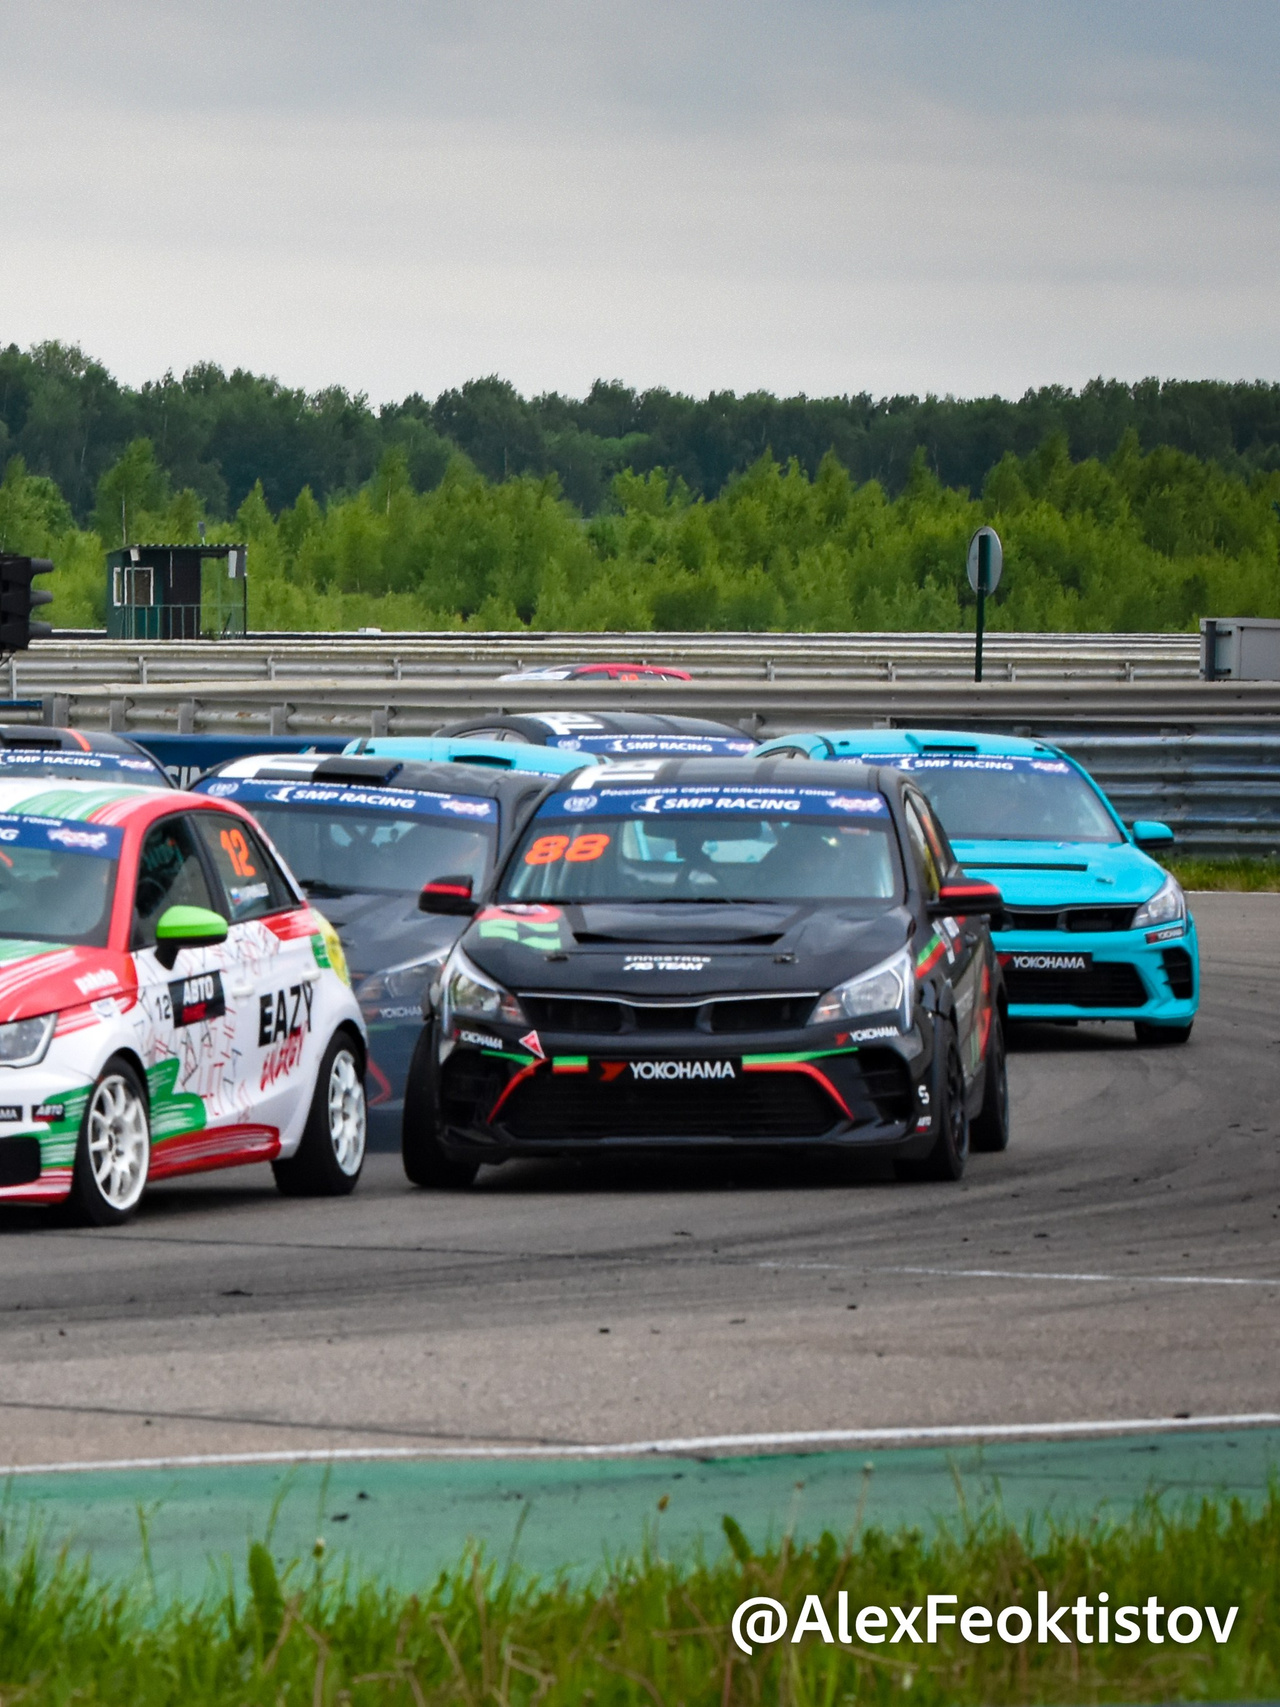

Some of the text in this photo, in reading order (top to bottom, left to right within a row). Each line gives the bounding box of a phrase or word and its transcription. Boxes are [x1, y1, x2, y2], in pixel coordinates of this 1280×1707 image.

[626, 741, 658, 751] SMP
[660, 741, 713, 752] RACING
[6, 754, 101, 767] SMP RACING
[914, 760, 1014, 771] SMP RACING
[292, 789, 416, 809] SMP RACING
[600, 786, 678, 797] Российская
[680, 786, 720, 796] серия
[798, 789, 837, 797] гонок
[663, 798, 802, 811] SMP RACING
[221, 829, 256, 877] 12
[525, 834, 610, 865] 88
[657, 962, 704, 971] TEAM
[1012, 955, 1086, 969] YOKOHAMA
[183, 975, 215, 1005] АВТО
[155, 994, 171, 1021] 12
[258, 980, 316, 1048] EAZY
[850, 1026, 901, 1043] YOKOHAMA
[629, 1061, 735, 1081] YOKOHAMA
